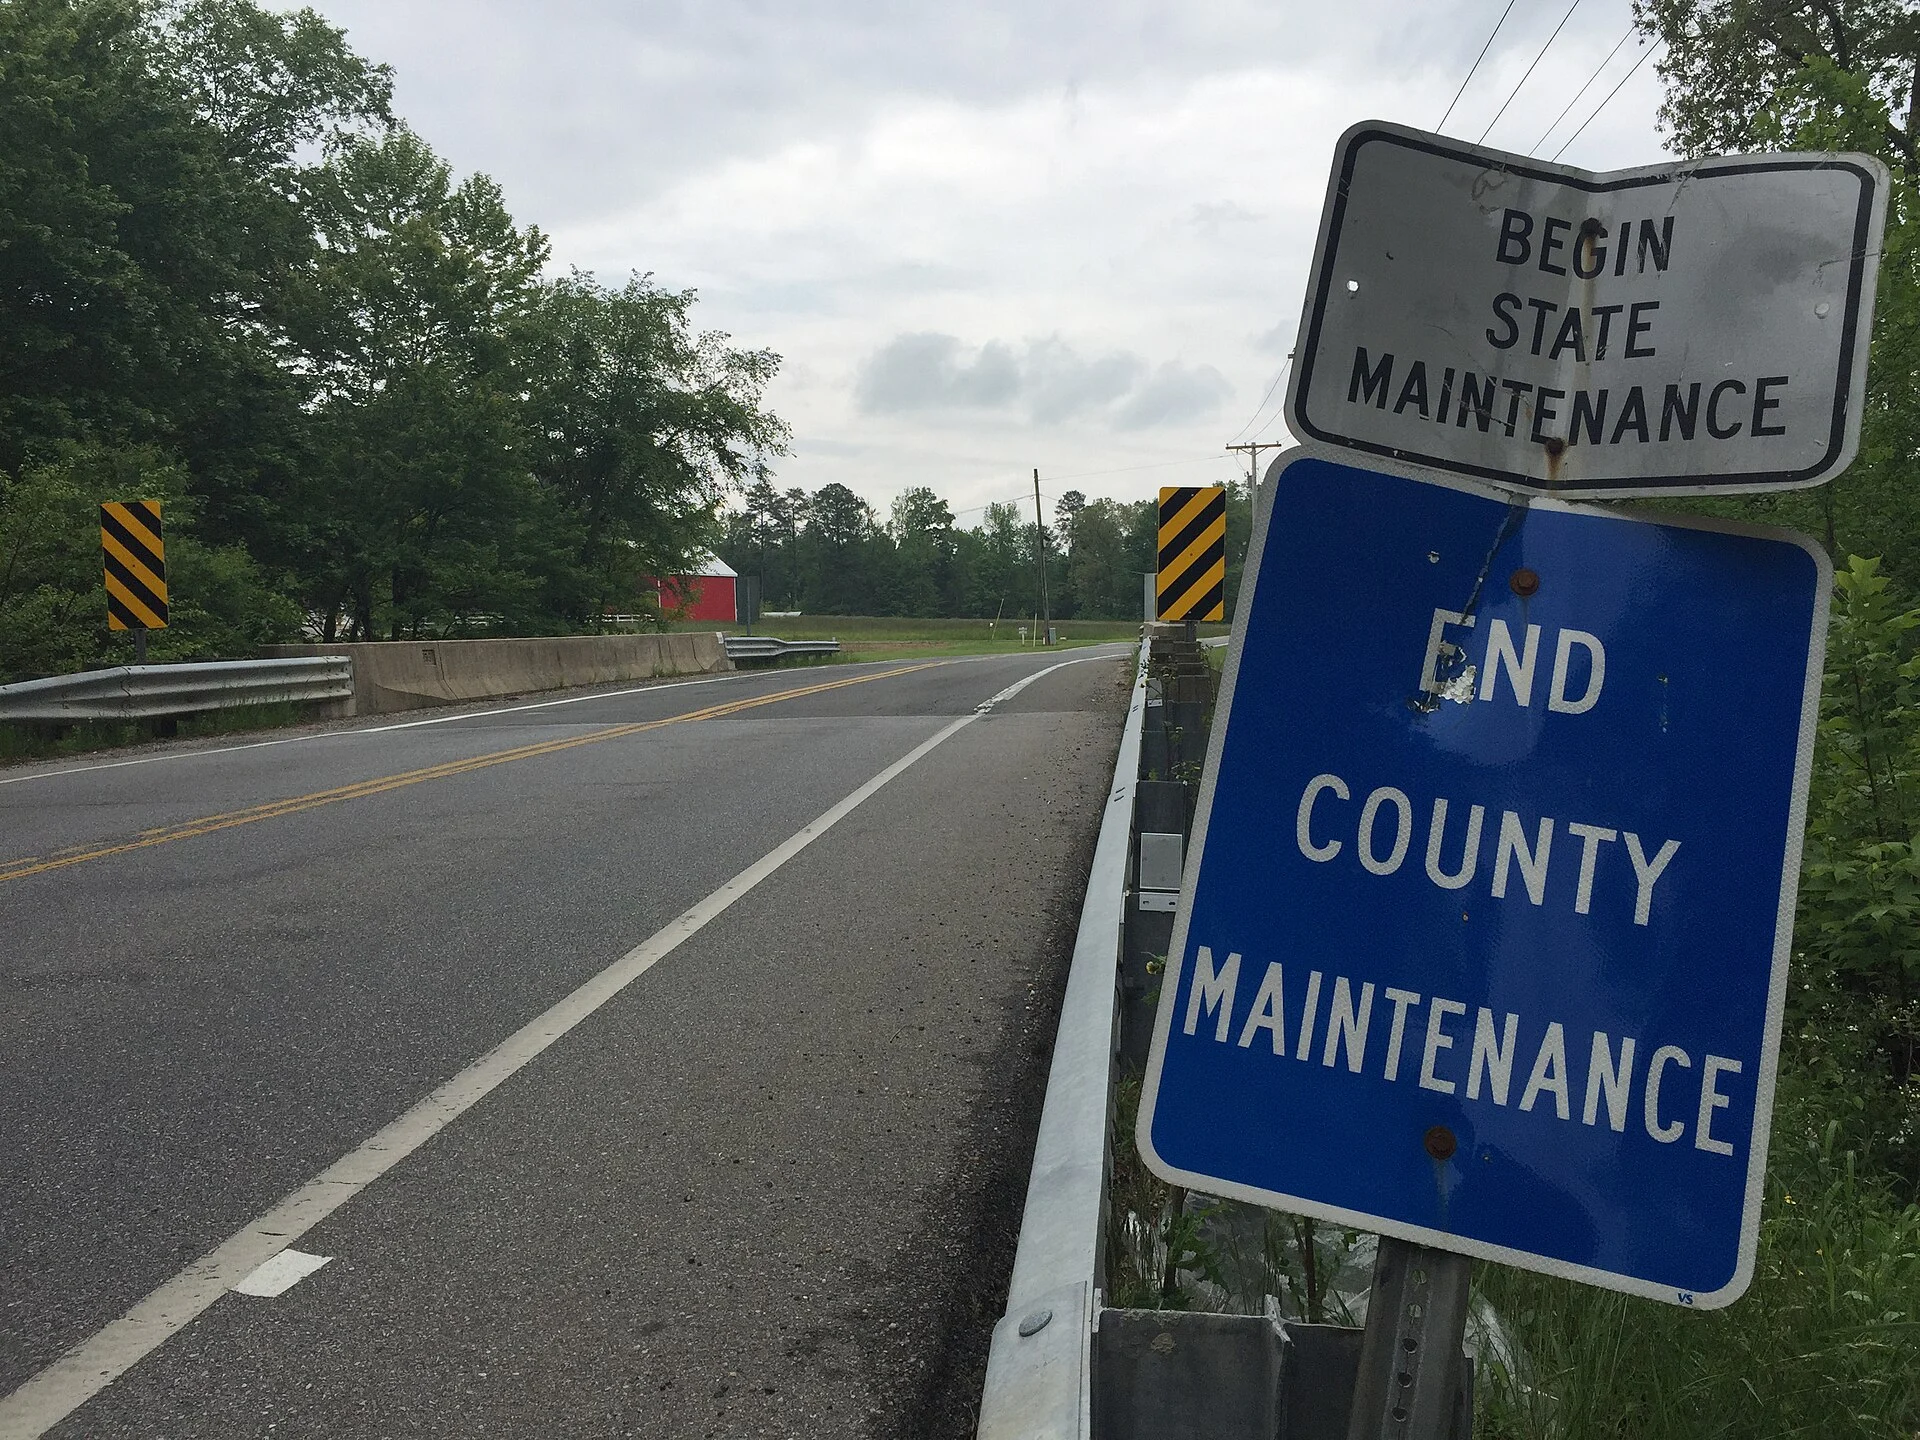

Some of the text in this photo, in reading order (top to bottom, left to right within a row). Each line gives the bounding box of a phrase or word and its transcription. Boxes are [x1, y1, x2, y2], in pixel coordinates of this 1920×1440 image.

[1496, 208, 1674, 280] BEGIN
[1487, 292, 1660, 362] STATE
[1348, 346, 1789, 446] MAINTENANCE
[1418, 607, 1607, 715] END
[1296, 773, 1682, 927] COUNTY
[1183, 945, 1743, 1157] MAINTENANCE
[1677, 1292, 1694, 1305] VS
